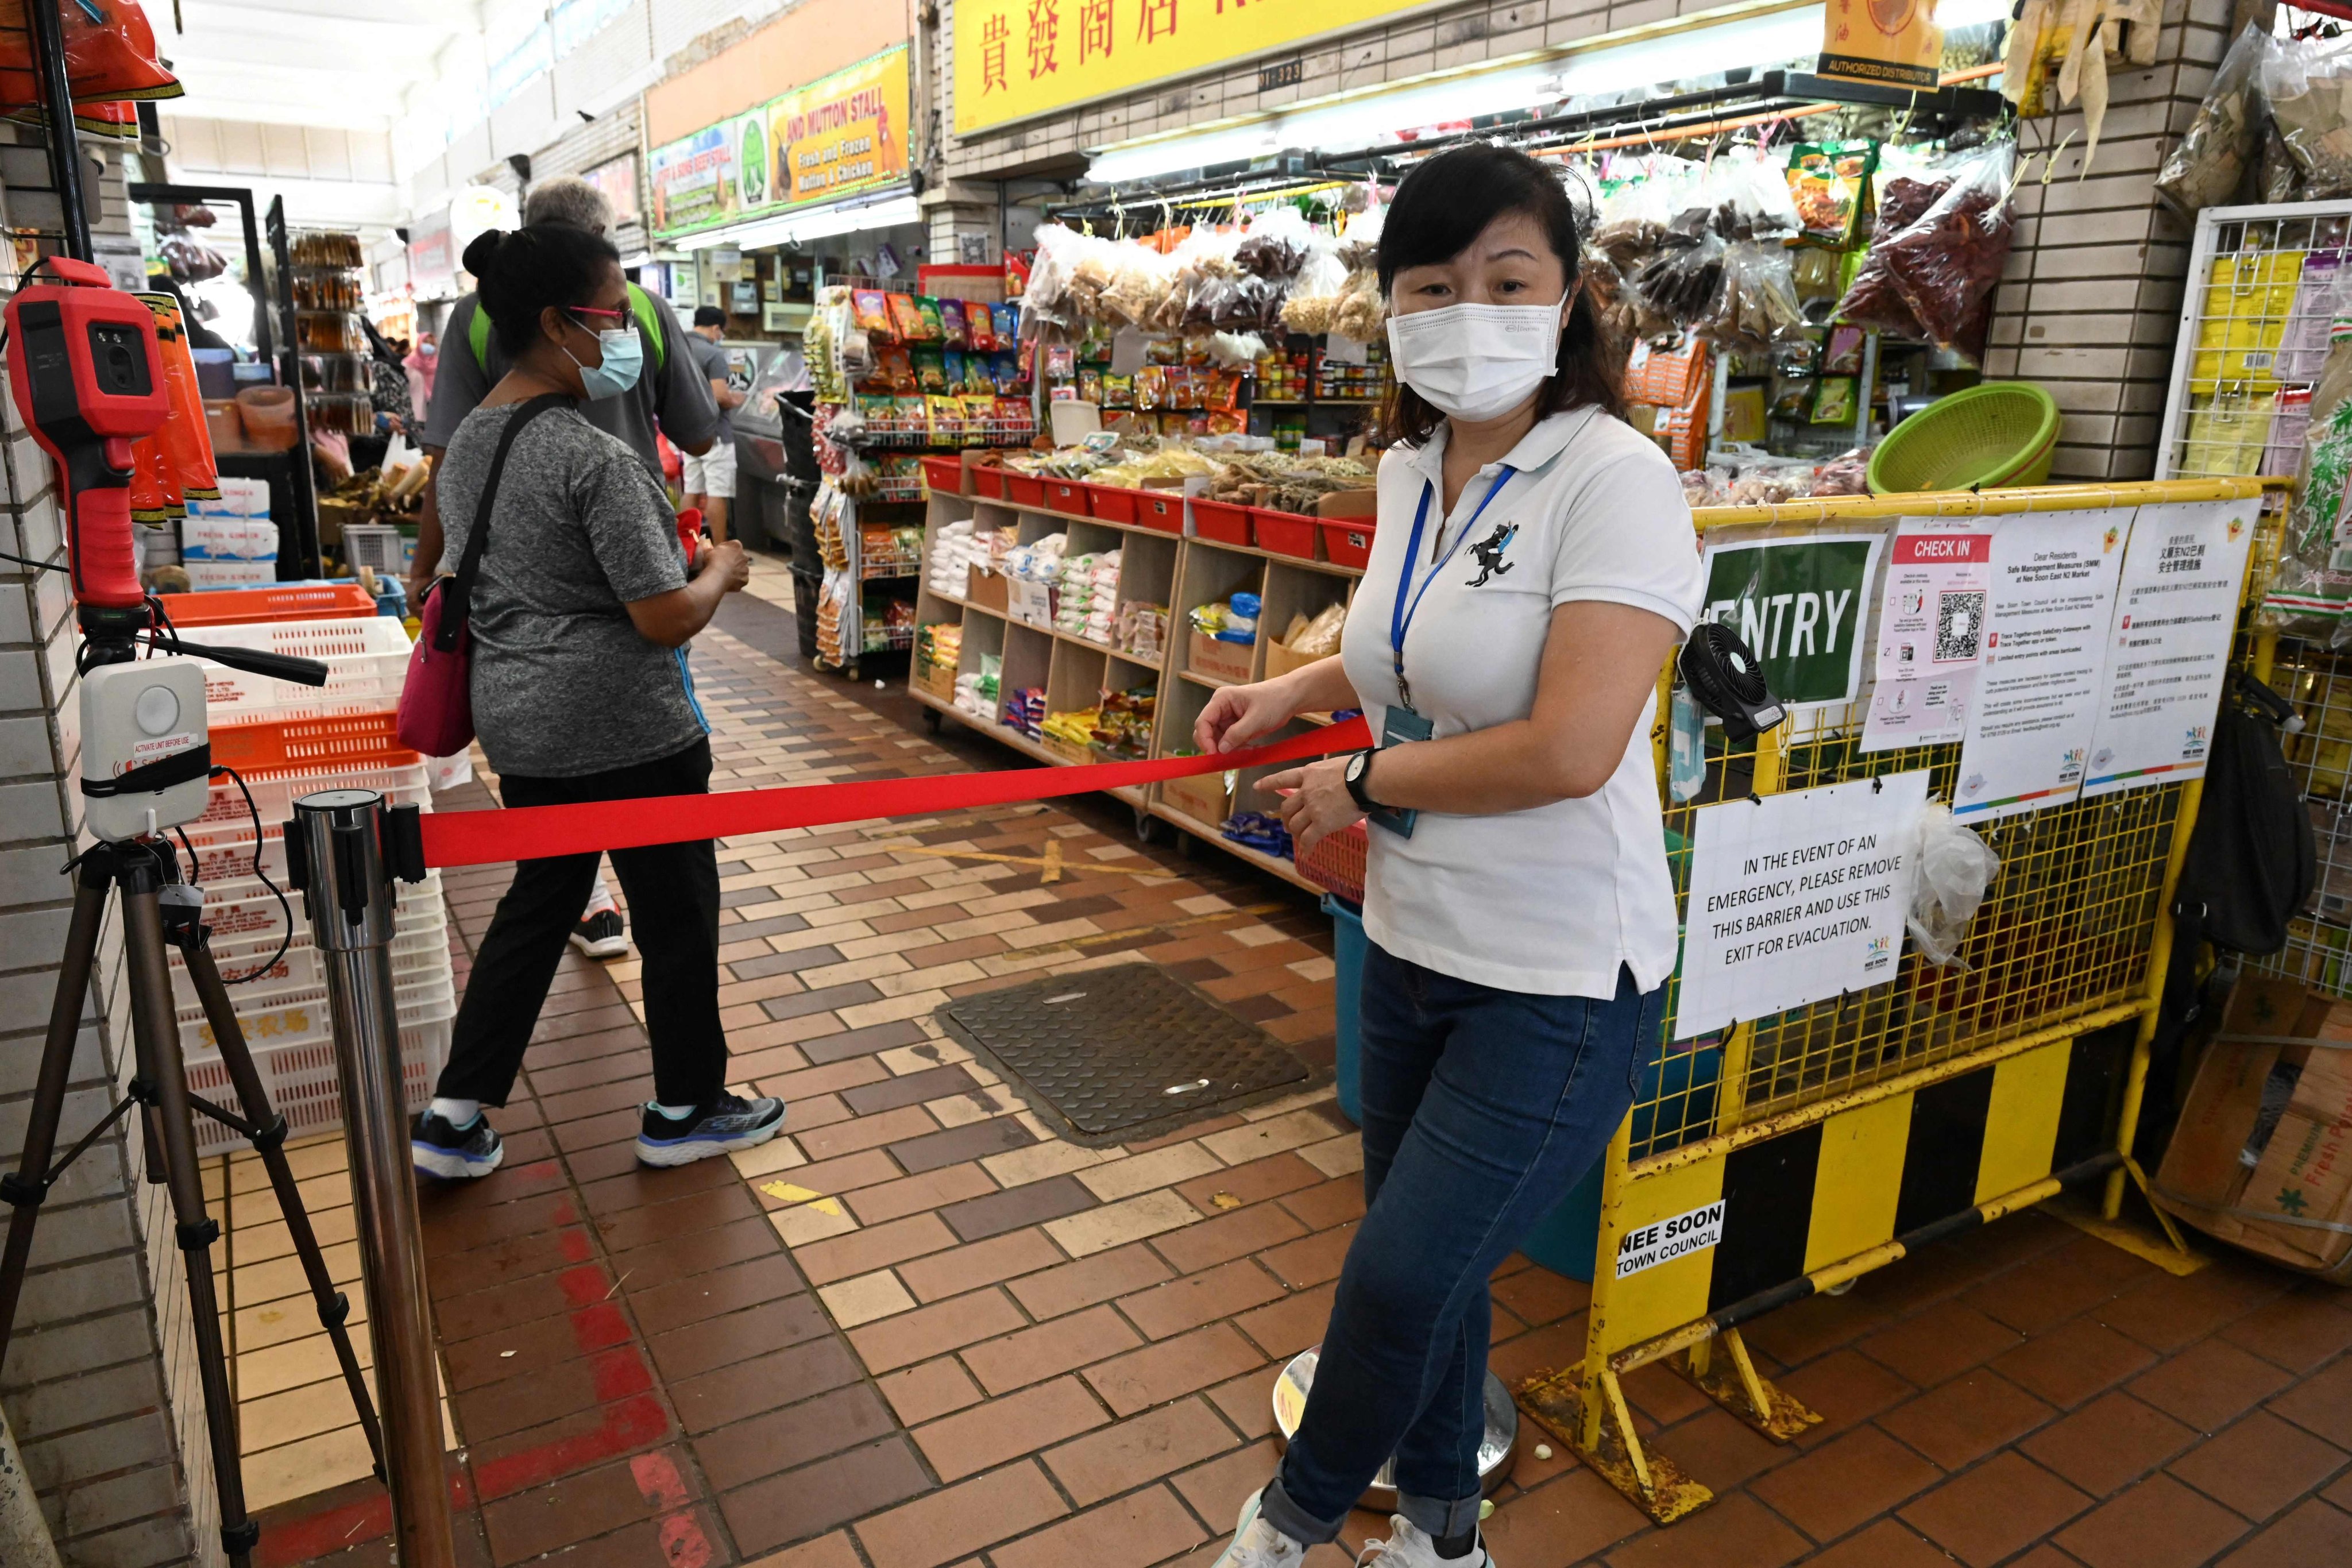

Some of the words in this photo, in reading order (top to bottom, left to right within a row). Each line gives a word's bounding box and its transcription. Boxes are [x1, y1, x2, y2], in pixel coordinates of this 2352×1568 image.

[1828, 60, 1881, 76] AUTHORIZED
[1882, 67, 1931, 83] DISTRIBUTOR
[787, 116, 804, 142] AND
[808, 99, 847, 136] MUTTON
[851, 87, 882, 122] STALL
[799, 150, 820, 168] Fresh
[823, 144, 838, 163] and
[841, 137, 871, 157] Frozen
[798, 172, 825, 192] Mutton
[829, 168, 835, 185] &
[838, 161, 873, 183] Chicken
[1914, 540, 1955, 557] CHECK
[1957, 540, 1970, 556] IN
[2034, 553, 2048, 561] Dear
[2049, 551, 2077, 560] Residents
[2160, 544, 2206, 559] 义顺东N2巴刹
[2007, 566, 2019, 574] Safe
[2021, 563, 2056, 573] Management
[2057, 561, 2082, 569] Measures
[2083, 559, 2100, 569] (SMM)
[2034, 573, 2048, 581] Soon
[2158, 558, 2202, 573] 安全管理措施
[1995, 610, 2020, 618] Management
[2013, 639, 2030, 647] Together
[2014, 630, 2041, 638] Together-only
[135, 743, 155, 753] ACTIVATE
[155, 741, 165, 750] UNIT
[165, 737, 181, 748] BEFORE
[1744, 858, 1758, 875] IN
[1763, 852, 1789, 870] THE
[1793, 843, 1835, 865] EVENT
[1838, 839, 1855, 855] OF
[1857, 835, 1877, 852] AN
[1708, 880, 1795, 912] EMERGENCY,
[1800, 868, 1845, 891] PLEASE
[1848, 856, 1902, 880] REMOVE
[1713, 920, 1742, 940] THIS
[1747, 906, 1802, 932] BARRIER
[1805, 898, 1833, 918] AND
[1837, 891, 1861, 910] USE
[1865, 885, 1890, 901] THIS
[1725, 944, 1754, 965] EXIT
[1758, 937, 1783, 957] FOR
[1787, 916, 1871, 949] EVACUATION.
[2290, 1121, 2323, 1175] PREMIUM
[2304, 1141, 2339, 1187] Fresh
[1665, 1204, 1721, 1239] SOON
[1617, 1251, 1656, 1275] TOWN
[1660, 1230, 1718, 1259] COUNCIL
